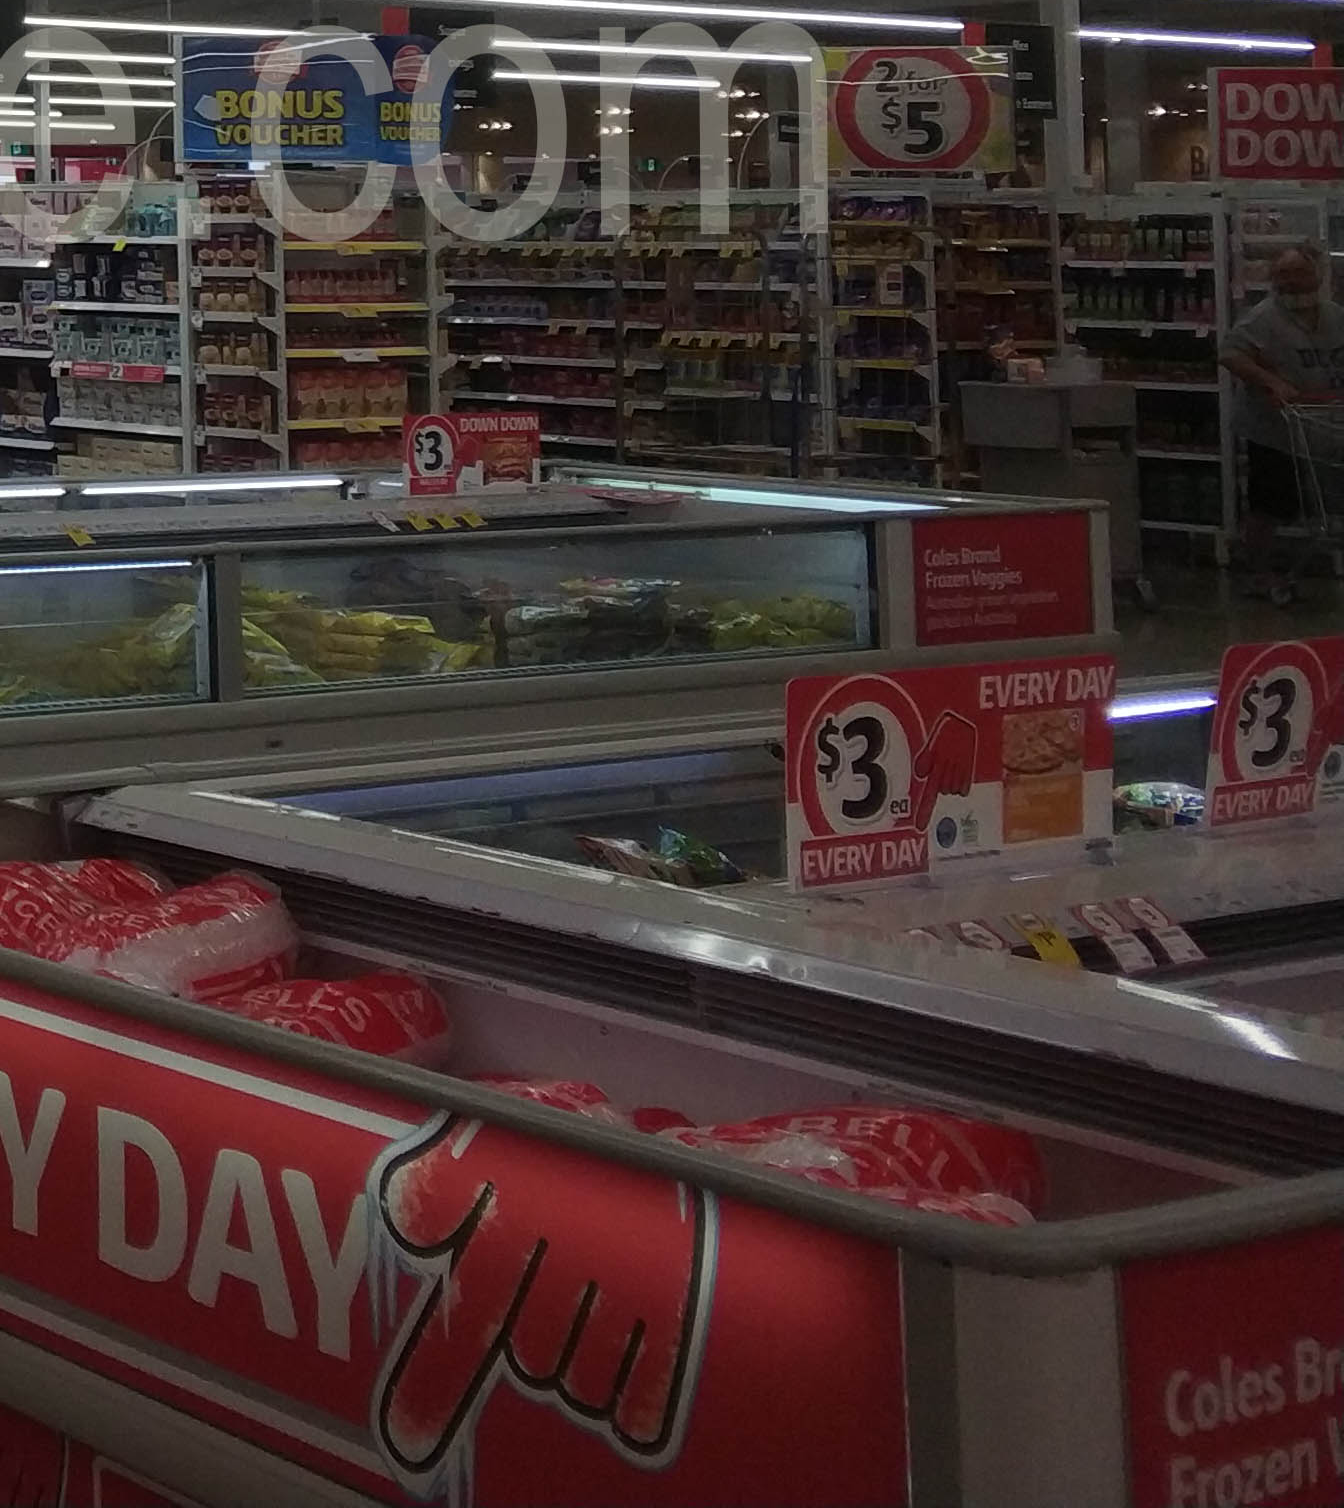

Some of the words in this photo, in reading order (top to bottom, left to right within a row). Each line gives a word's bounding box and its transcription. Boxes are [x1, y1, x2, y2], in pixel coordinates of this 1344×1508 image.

[875, 61, 900, 93] 2
[906, 71, 948, 93] for
[215, 90, 345, 120] BONUS
[380, 101, 442, 123] BONUS
[215, 124, 345, 146] VOUCHER
[380, 125, 442, 142] VOUCHER
[882, 97, 944, 155] $5
[459, 417, 499, 433] DOWN
[500, 416, 540, 432] DOWN
[415, 431, 444, 471] $3
[924, 548, 960, 567] Coles
[961, 544, 1002, 565] Brand
[925, 570, 971, 589] Frozen
[971, 567, 1023, 591] Veggies
[979, 670, 1061, 710] EVERY
[1065, 665, 1115, 701] DAY
[1238, 678, 1297, 767] $3
[817, 716, 889, 819] $3
[890, 798, 910, 815] ea
[1214, 789, 1273, 820] EVERY
[1275, 783, 1315, 812] DAY
[801, 842, 874, 878] EVERY
[881, 837, 928, 869] DAY
[96, 1104, 370, 1363] DAY
[1164, 1354, 1287, 1438] Coles
[1169, 1438, 1319, 1508] Frozen
